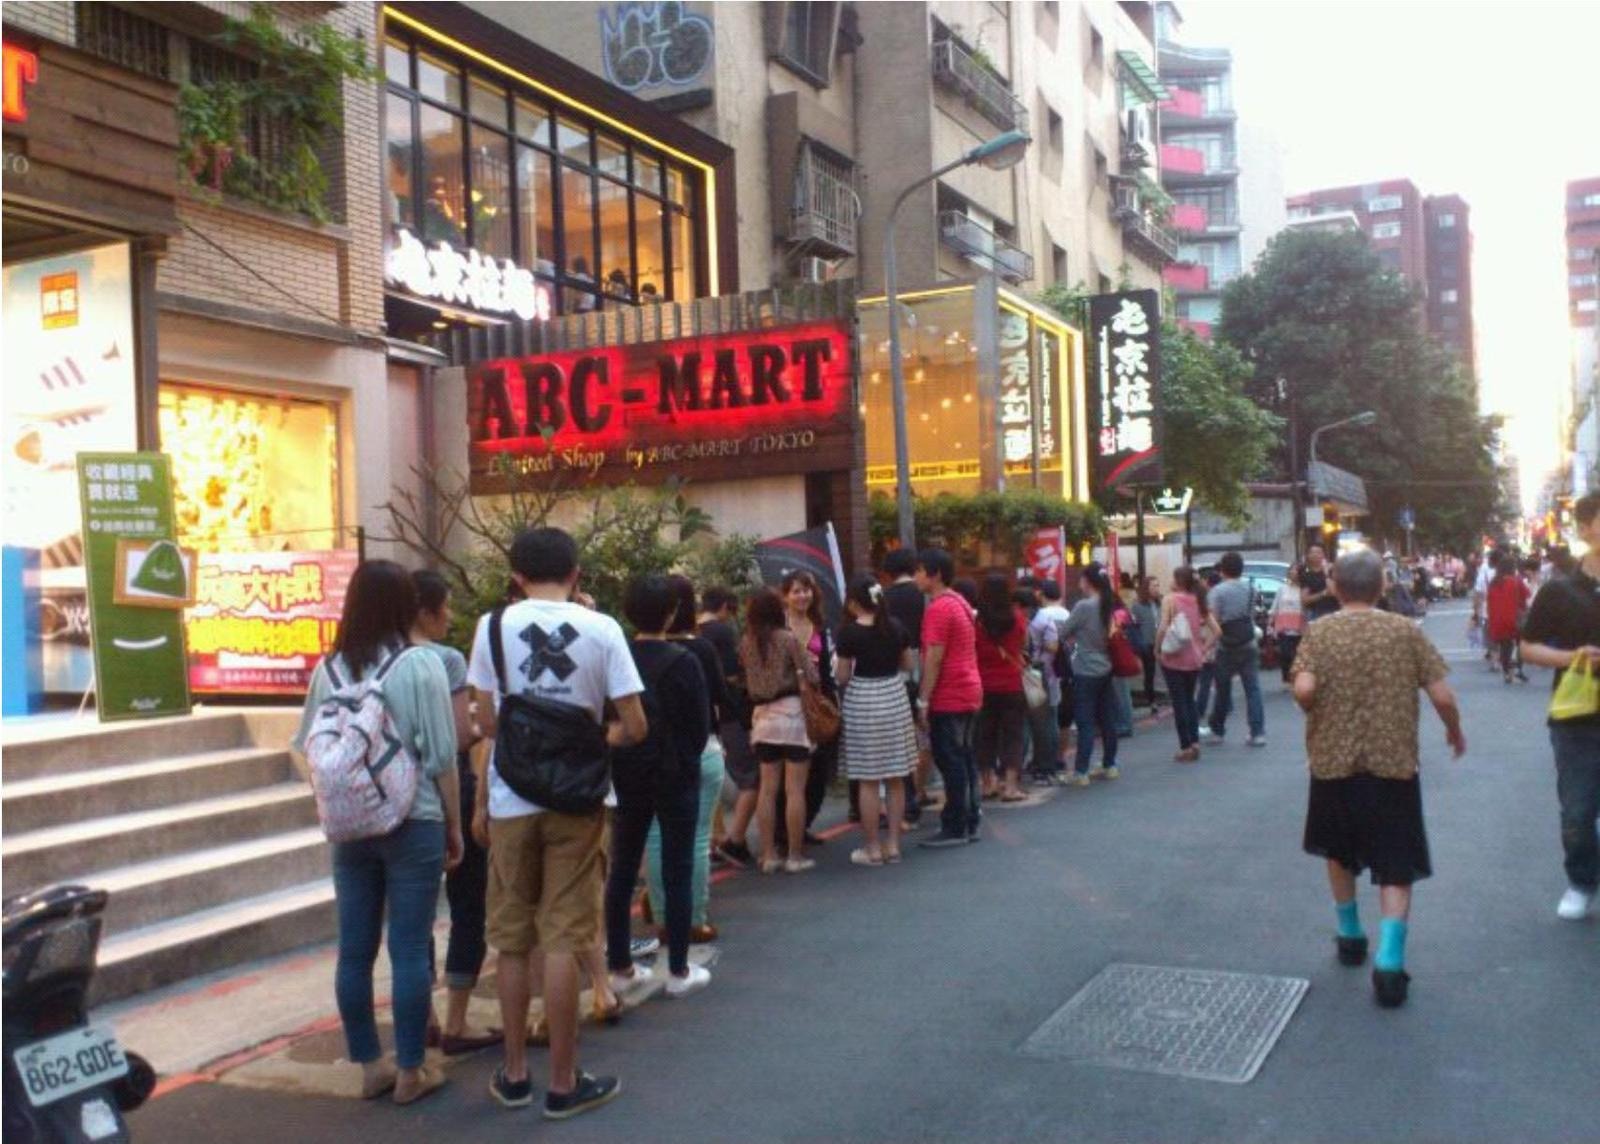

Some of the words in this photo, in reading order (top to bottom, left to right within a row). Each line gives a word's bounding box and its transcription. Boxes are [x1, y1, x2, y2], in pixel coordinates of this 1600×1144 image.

[562, 442, 605, 479] Shop
[625, 448, 644, 470] by
[751, 429, 815, 452] TOKYO
[26, 1039, 124, 1095] 862-GDE
